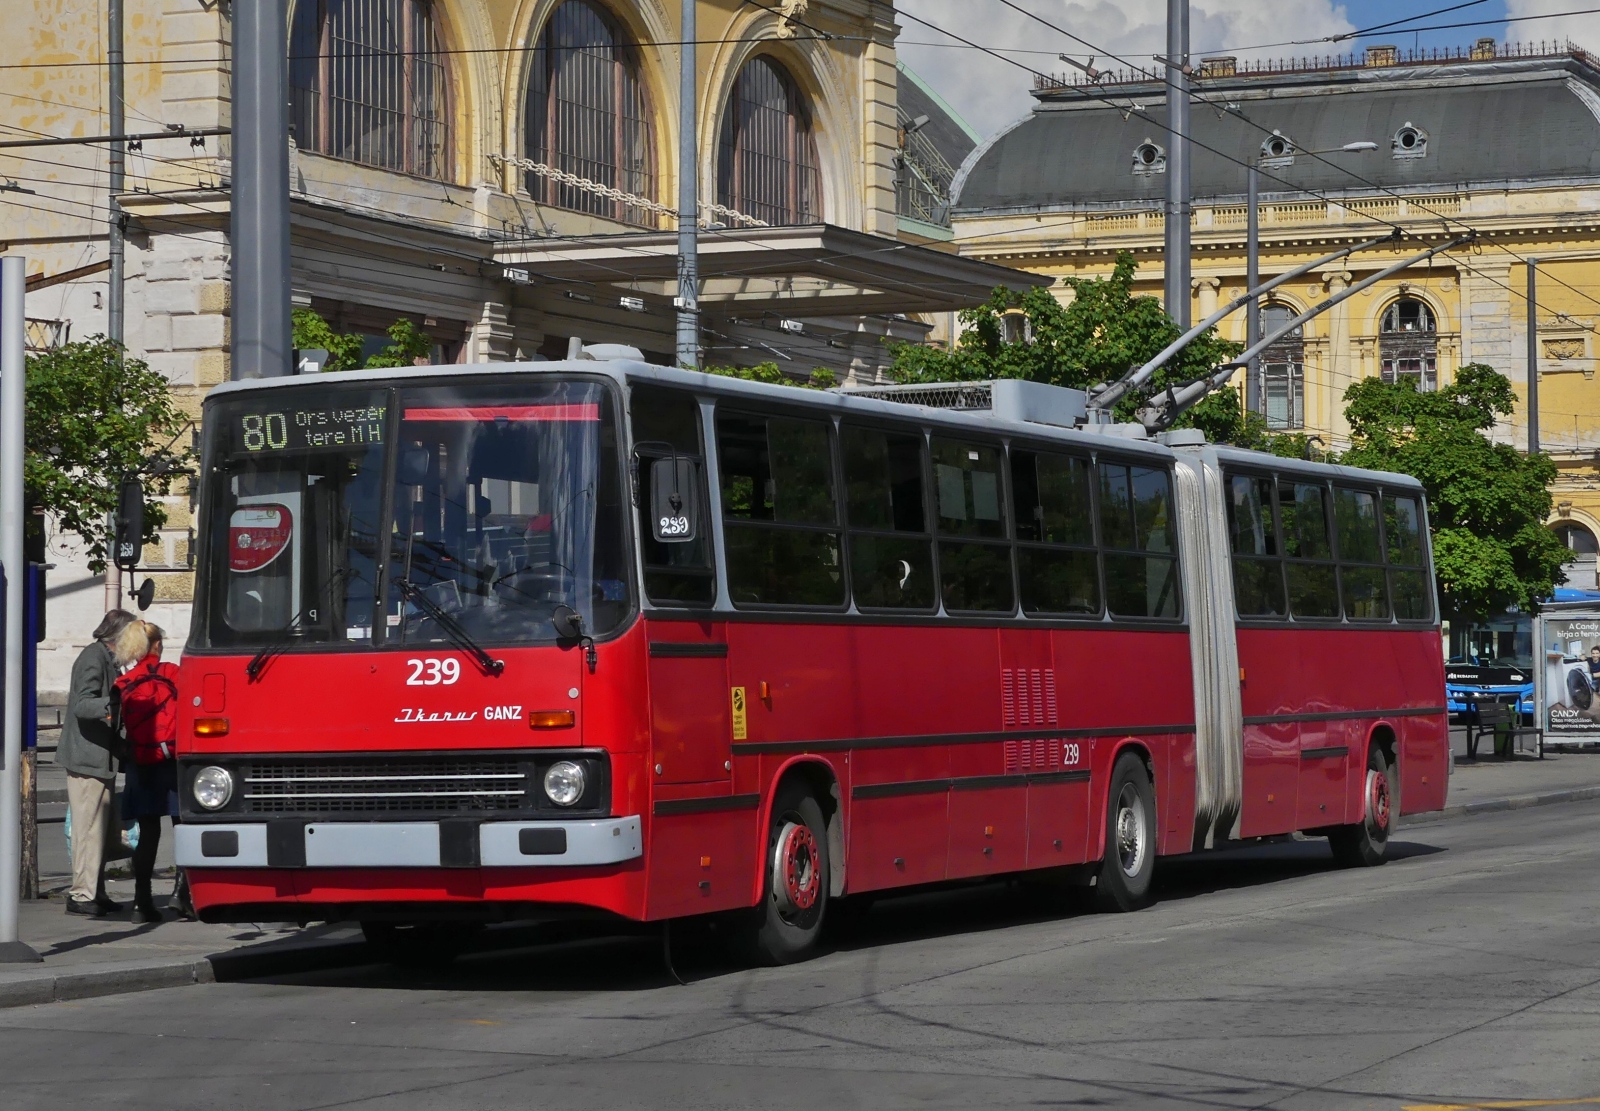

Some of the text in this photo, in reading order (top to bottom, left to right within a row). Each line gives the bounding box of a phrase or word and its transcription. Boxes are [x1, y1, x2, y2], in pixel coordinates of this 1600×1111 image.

[242, 413, 288, 450] 80
[305, 429, 345, 446] tere
[1568, 622, 1599, 632] A Candy
[406, 657, 461, 686] 239
[394, 705, 522, 722] Ikarus GANZ
[1551, 709, 1579, 718] CANDY
[1063, 743, 1080, 765] 239
